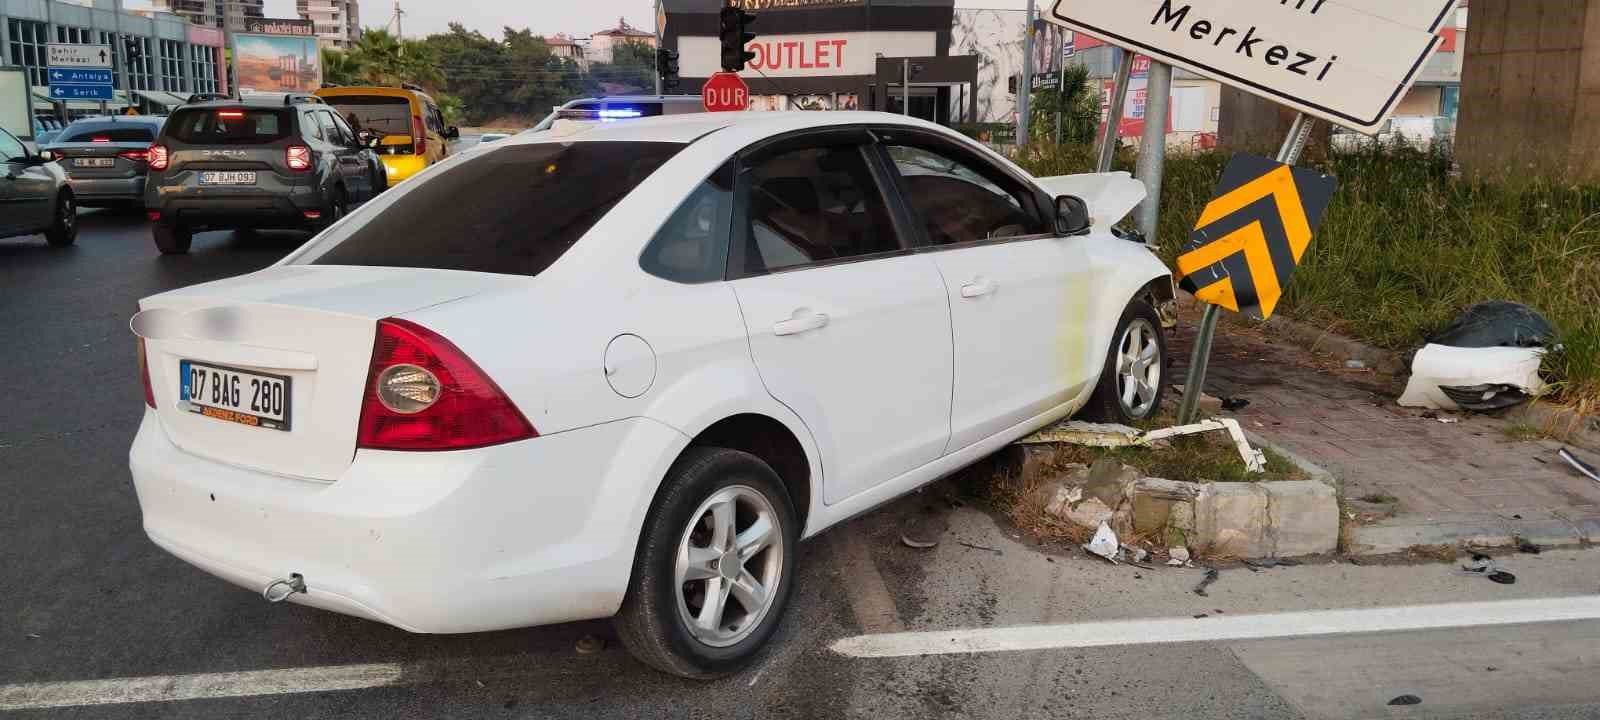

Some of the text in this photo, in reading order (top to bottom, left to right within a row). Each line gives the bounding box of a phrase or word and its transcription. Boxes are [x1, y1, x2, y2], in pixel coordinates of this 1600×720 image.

[1150, 0, 1338, 81] Merkezi
[749, 39, 848, 70] OUTLET
[72, 72, 109, 81] Antalya
[73, 88, 99, 96] Serik
[706, 87, 745, 106] DUR
[190, 368, 283, 415] 07 BAG 280
